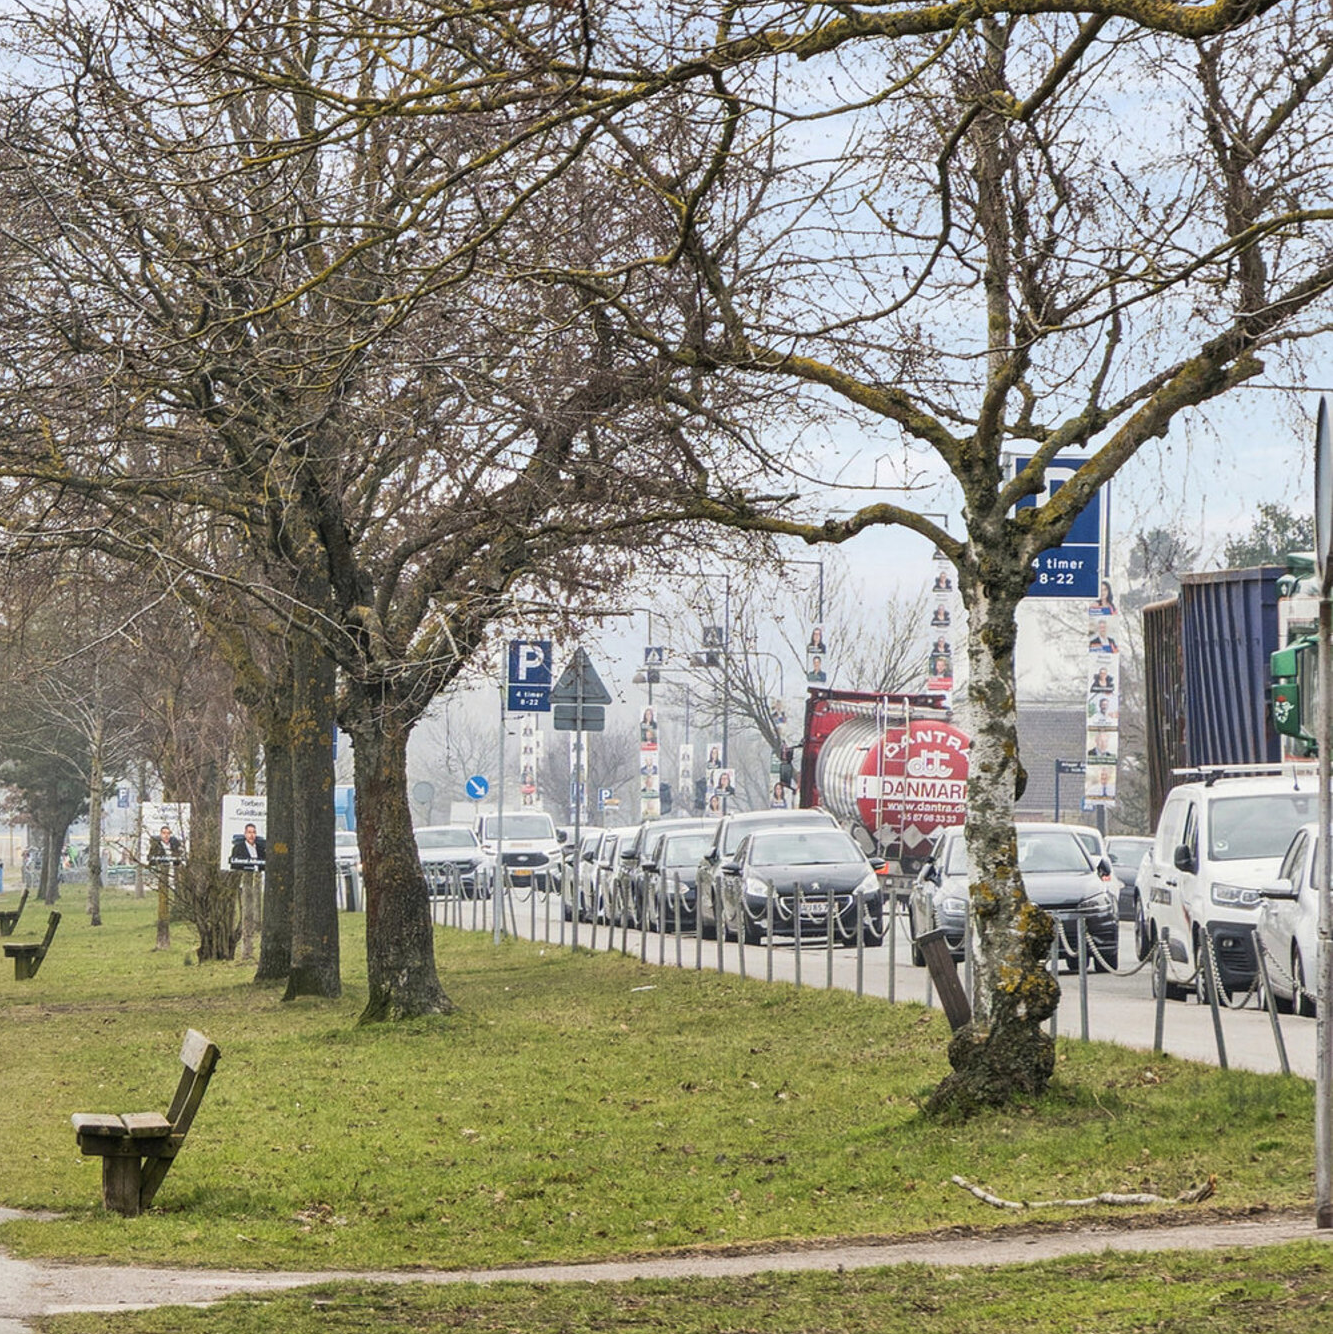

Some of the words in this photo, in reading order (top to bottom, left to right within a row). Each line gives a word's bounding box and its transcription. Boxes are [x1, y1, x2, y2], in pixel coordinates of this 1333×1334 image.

[1031, 557, 1040, 569] 4
[1046, 557, 1084, 569] timer
[1039, 573, 1074, 584] 8-22
[519, 644, 544, 680] P
[524, 690, 544, 698] timer
[520, 698, 539, 706] 8-22
[883, 780, 968, 799] DANMAR
